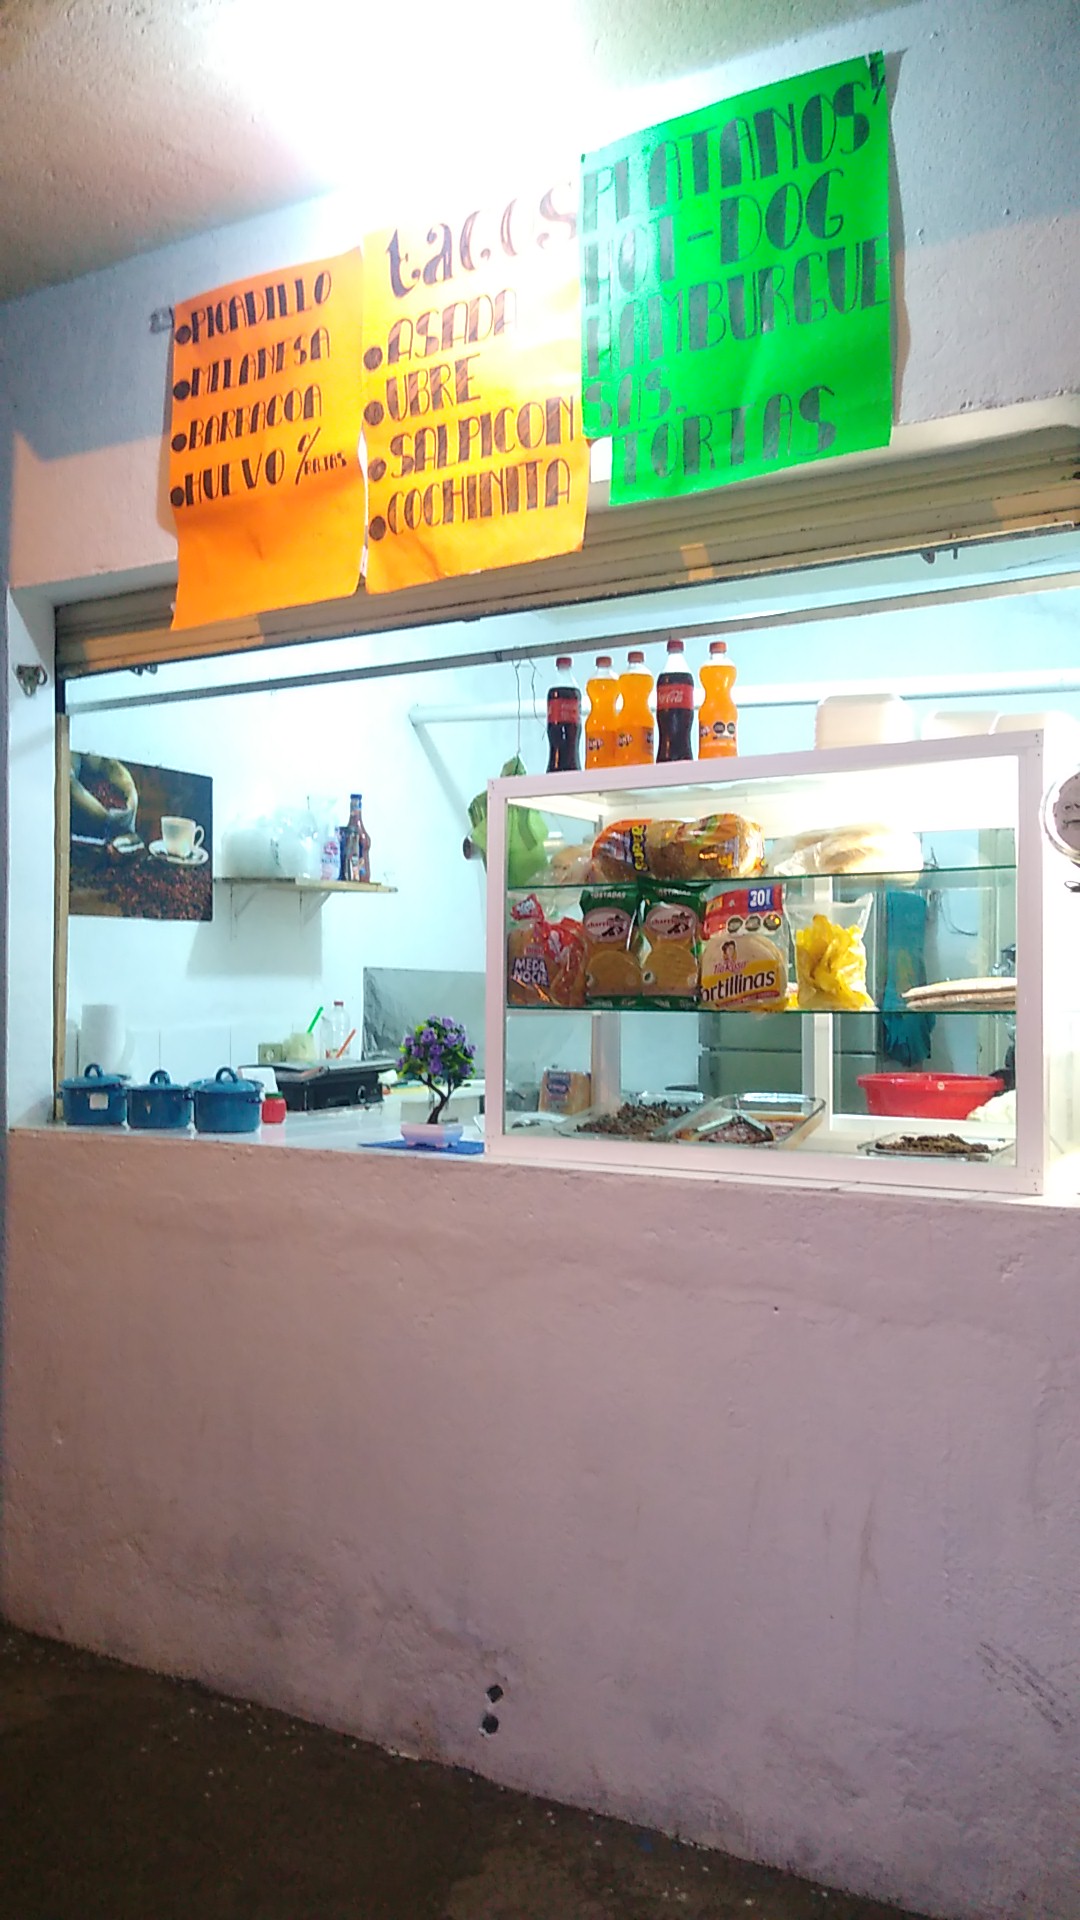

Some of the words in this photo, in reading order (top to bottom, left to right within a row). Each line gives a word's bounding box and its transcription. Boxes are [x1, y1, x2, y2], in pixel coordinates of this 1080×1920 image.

[582, 81, 870, 233] PLATANOS
[584, 168, 844, 308] HOT-DOG
[190, 270, 332, 344] PICADILLO
[388, 288, 517, 365] ASADA
[586, 236, 890, 377] HAMBURGUE
[190, 327, 330, 397] MILANESA
[386, 353, 481, 421] UBRE
[188, 384, 322, 450] BARBACOA
[390, 395, 574, 479] SALPICON
[613, 385, 837, 485] TORTAS
[185, 447, 285, 507] HUEVO
[386, 458, 571, 535] COCHINITA
[699, 970, 775, 1001] ortillinas
